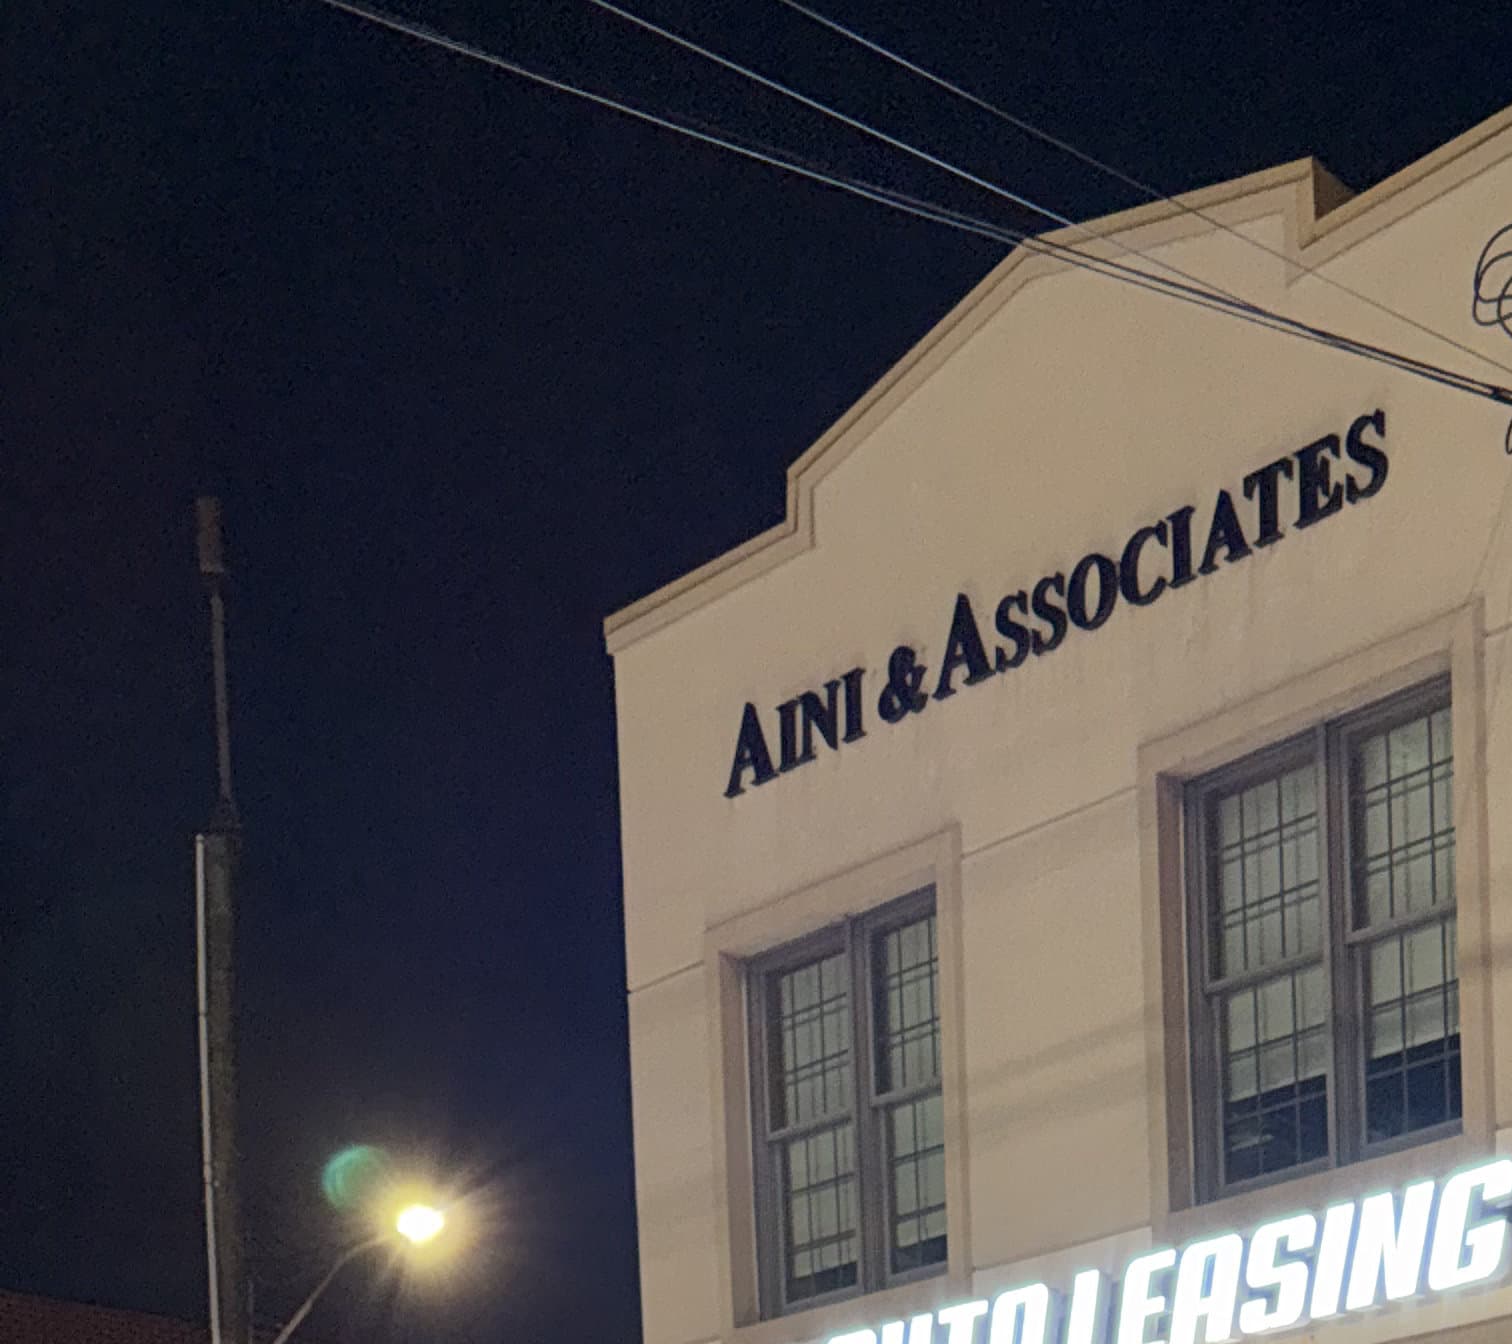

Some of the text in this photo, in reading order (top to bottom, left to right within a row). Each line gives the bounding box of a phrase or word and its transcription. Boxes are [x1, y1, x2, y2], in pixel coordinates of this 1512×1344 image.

[723, 408, 1390, 798] AINI & ASSOCIATES
